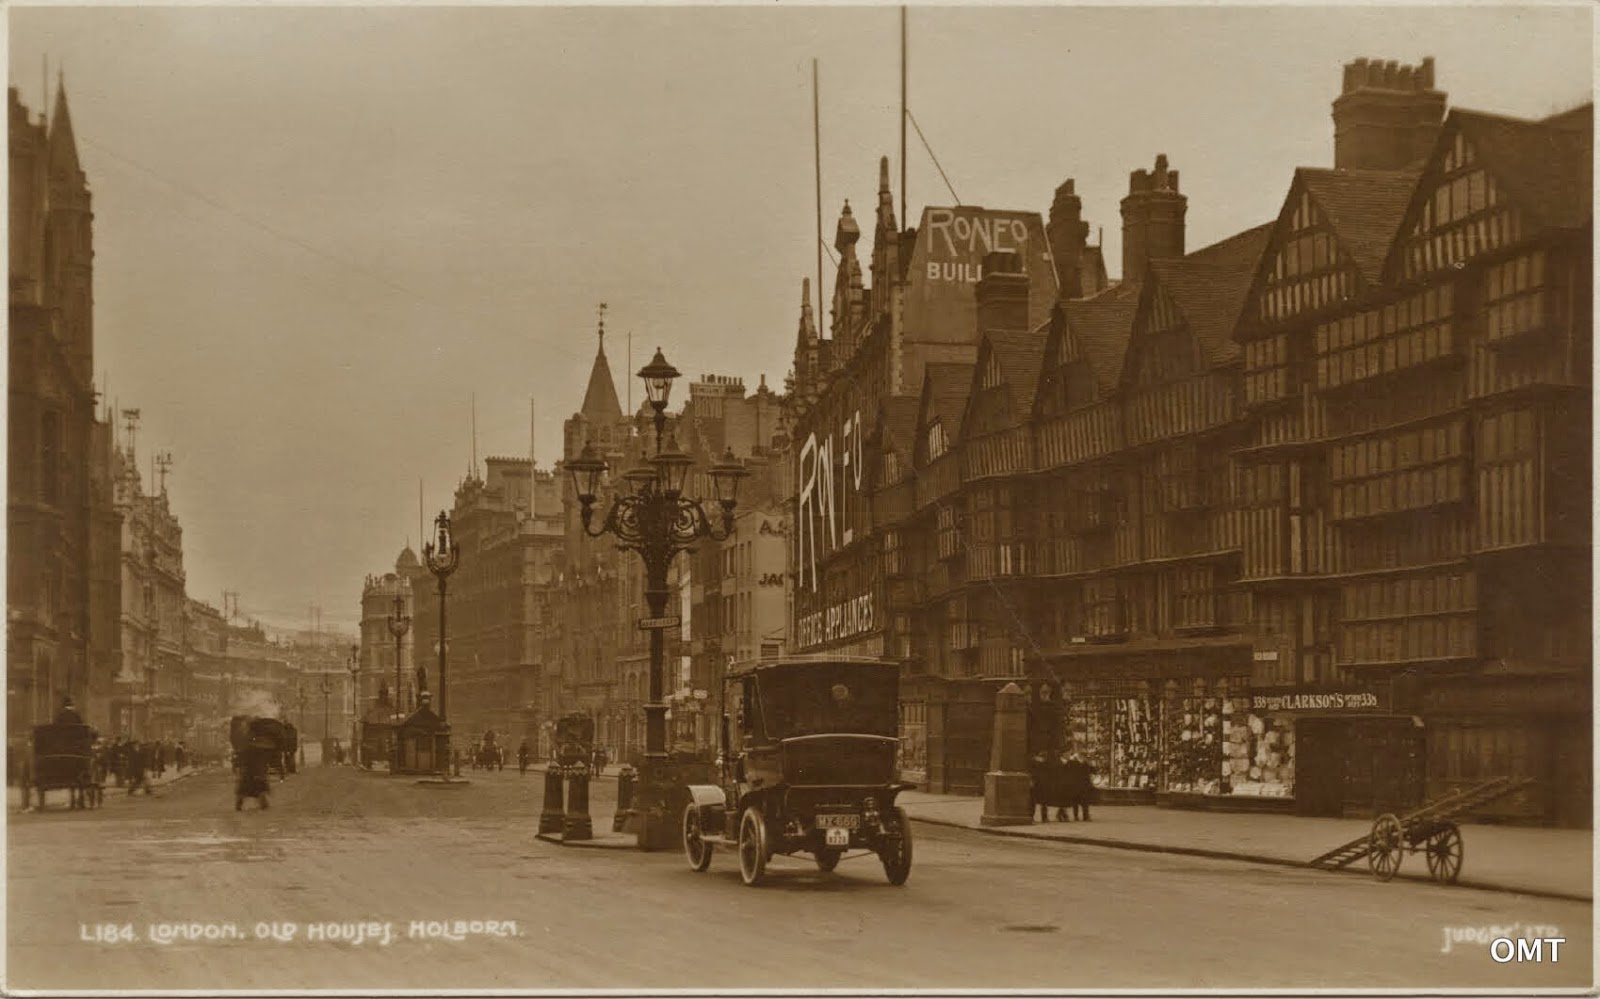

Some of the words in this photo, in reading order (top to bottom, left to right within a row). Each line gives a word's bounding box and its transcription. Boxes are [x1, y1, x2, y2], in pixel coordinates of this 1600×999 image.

[927, 209, 1028, 256] RONEO
[800, 409, 862, 593] RONEO
[1281, 692, 1344, 710] CLARKSON'S
